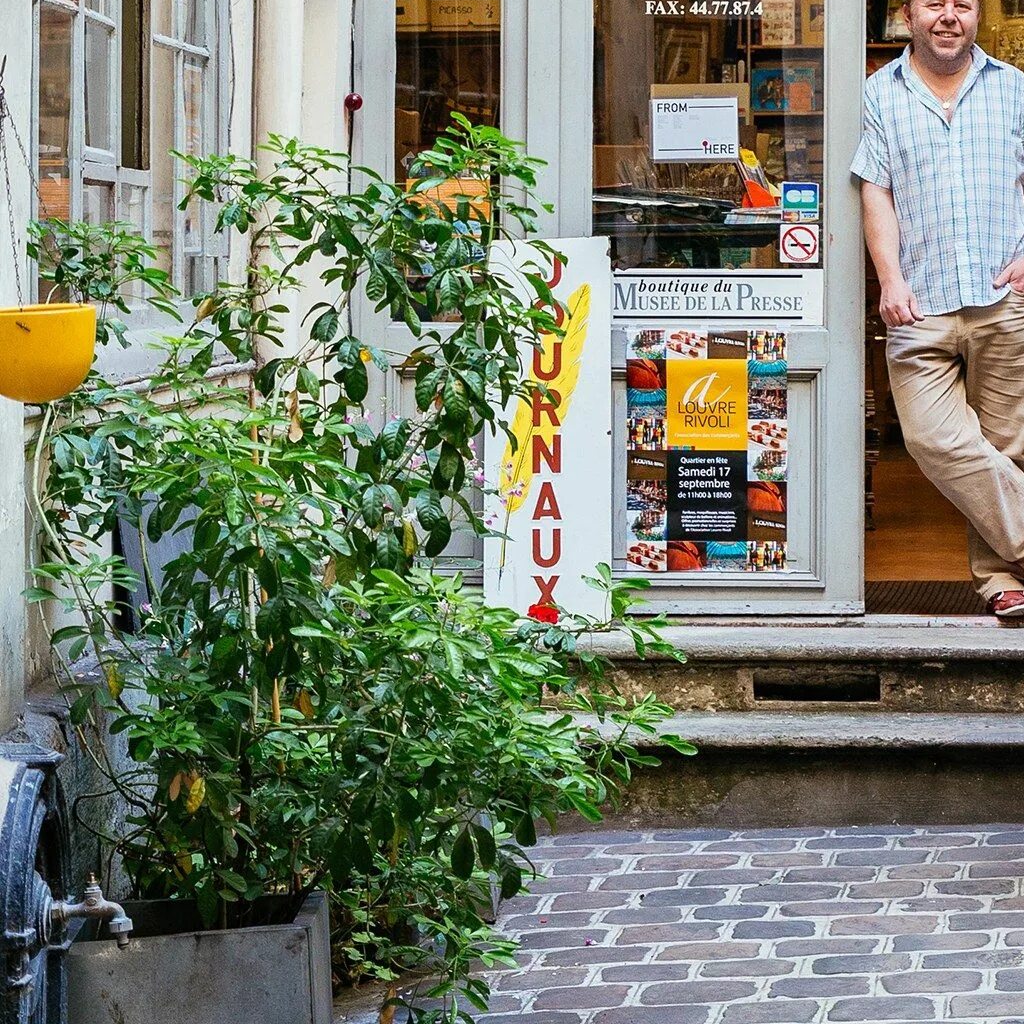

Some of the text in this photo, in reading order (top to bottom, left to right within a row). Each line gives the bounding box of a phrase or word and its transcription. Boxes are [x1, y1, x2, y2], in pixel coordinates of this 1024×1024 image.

[438, 5, 474, 15] PICASSO
[645, 1, 764, 15] FAX: 44.77.87.4
[656, 103, 688, 113] FROM
[703, 143, 735, 154] HERE
[638, 279, 733, 295] boutique du
[613, 282, 803, 311] MUSEE DE LA PRESSE
[677, 401, 737, 414] LOUVRE
[684, 414, 731, 428] RIVOLI
[680, 456, 706, 464] Quartier
[677, 466, 731, 477] Samedi 17
[678, 478, 730, 490] septembre
[677, 491, 687, 499] de
[713, 491, 732, 499] 18h00
